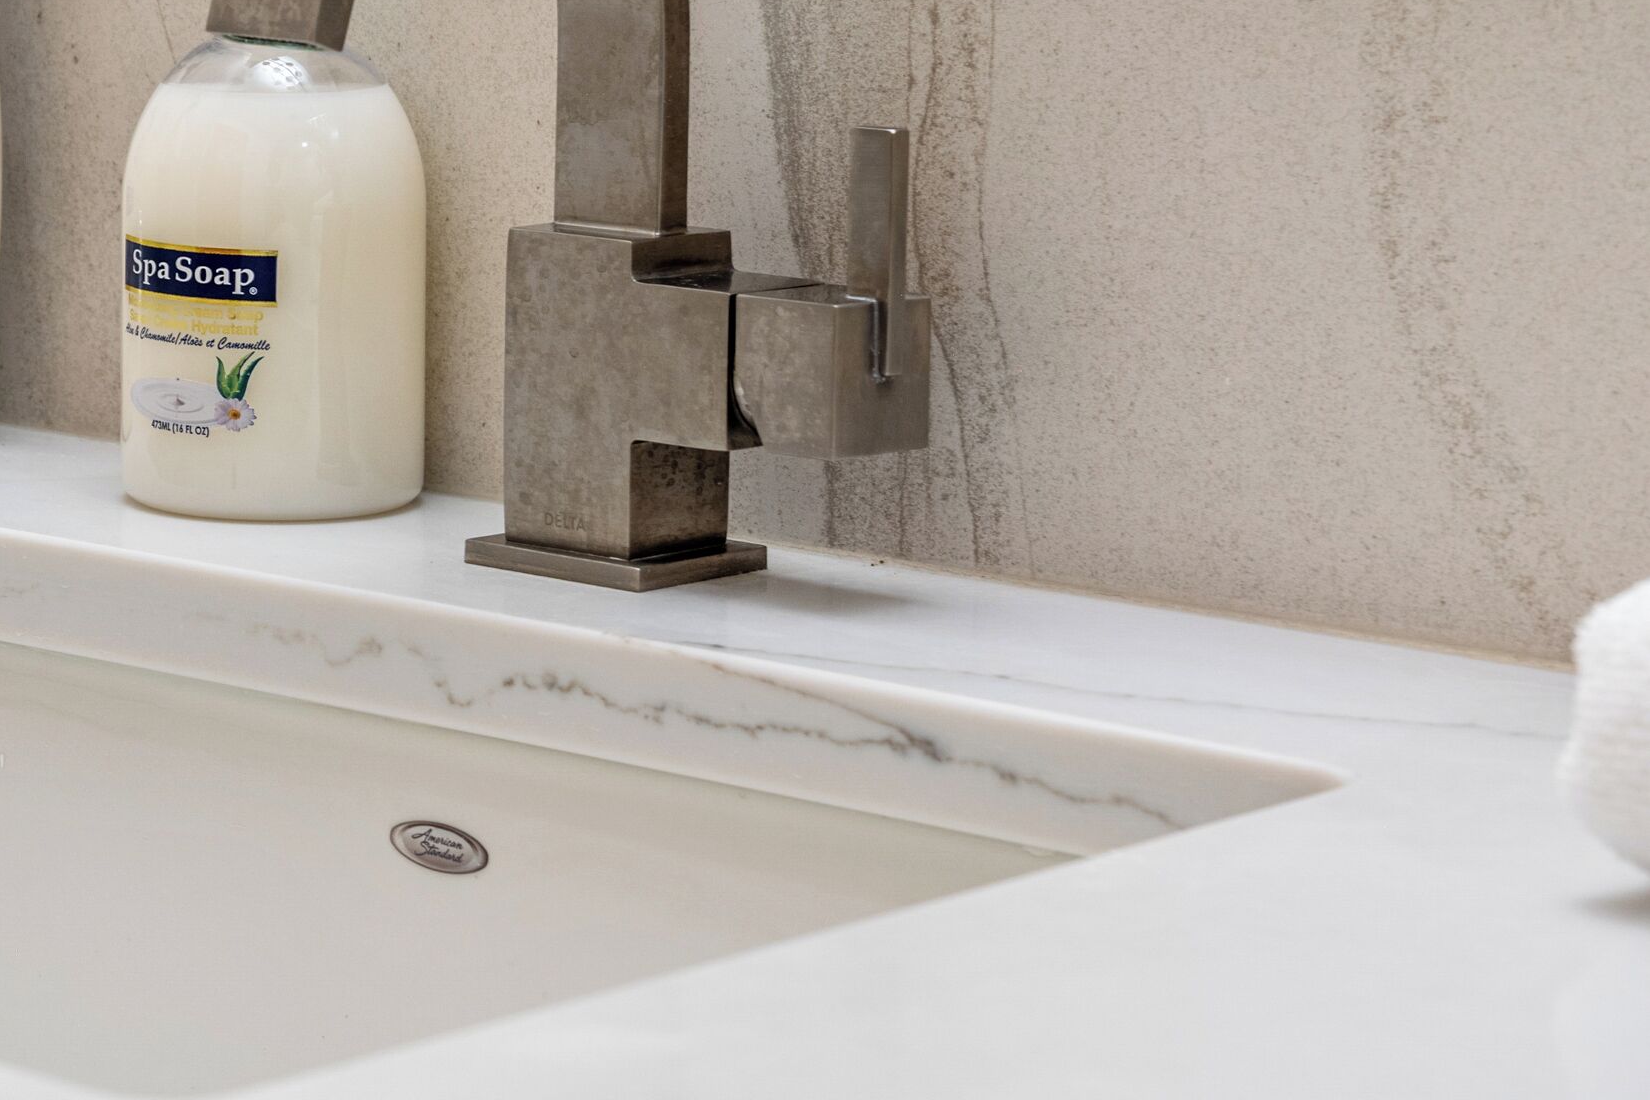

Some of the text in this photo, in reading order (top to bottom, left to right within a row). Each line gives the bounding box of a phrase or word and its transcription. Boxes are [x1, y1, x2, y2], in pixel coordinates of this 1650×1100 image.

[132, 249, 170, 285] Spa
[206, 339, 214, 348] et
[218, 337, 270, 351] Camomille
[544, 512, 586, 532] DELTA
[412, 829, 464, 849] American
[415, 842, 464, 863] Standard
